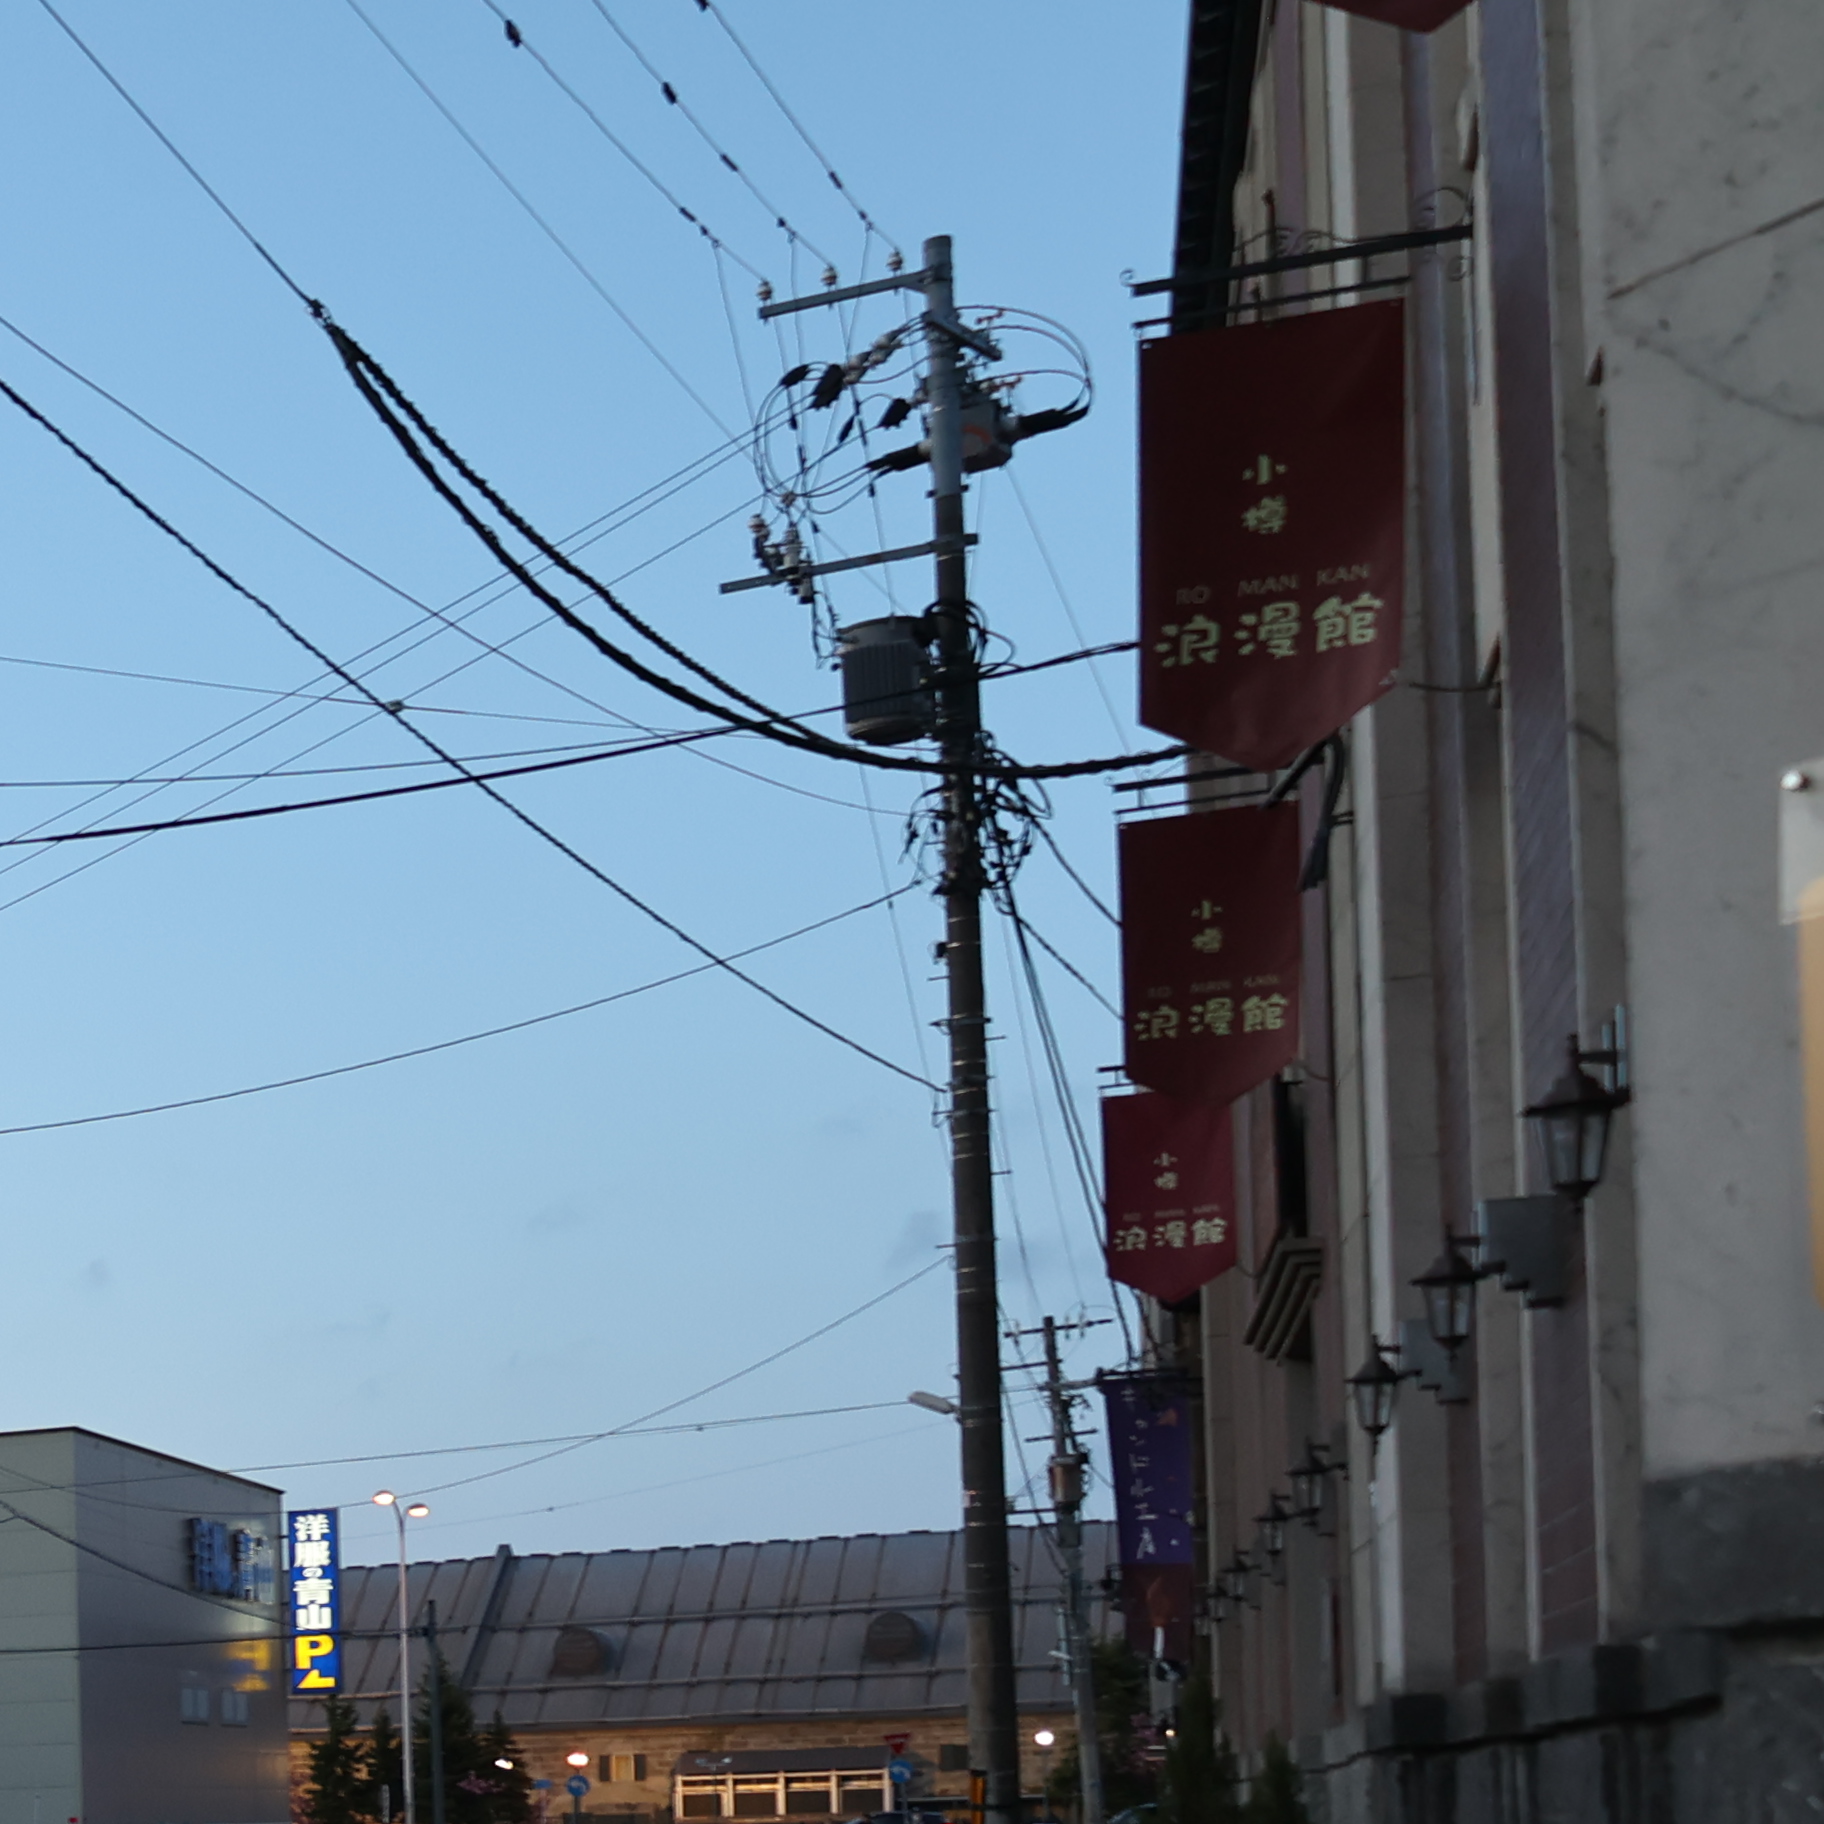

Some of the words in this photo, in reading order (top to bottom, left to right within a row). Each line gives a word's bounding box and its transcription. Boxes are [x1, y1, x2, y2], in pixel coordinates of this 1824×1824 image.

[1241, 453, 1289, 535] 小樽
[1237, 574, 1299, 597] MAN
[1316, 562, 1371, 586] KAN
[1153, 591, 1385, 668] 浪漫館
[1133, 992, 1289, 1041] 浪漫館
[293, 1513, 334, 1631] 洋服の青山
[294, 1633, 335, 1670] P
